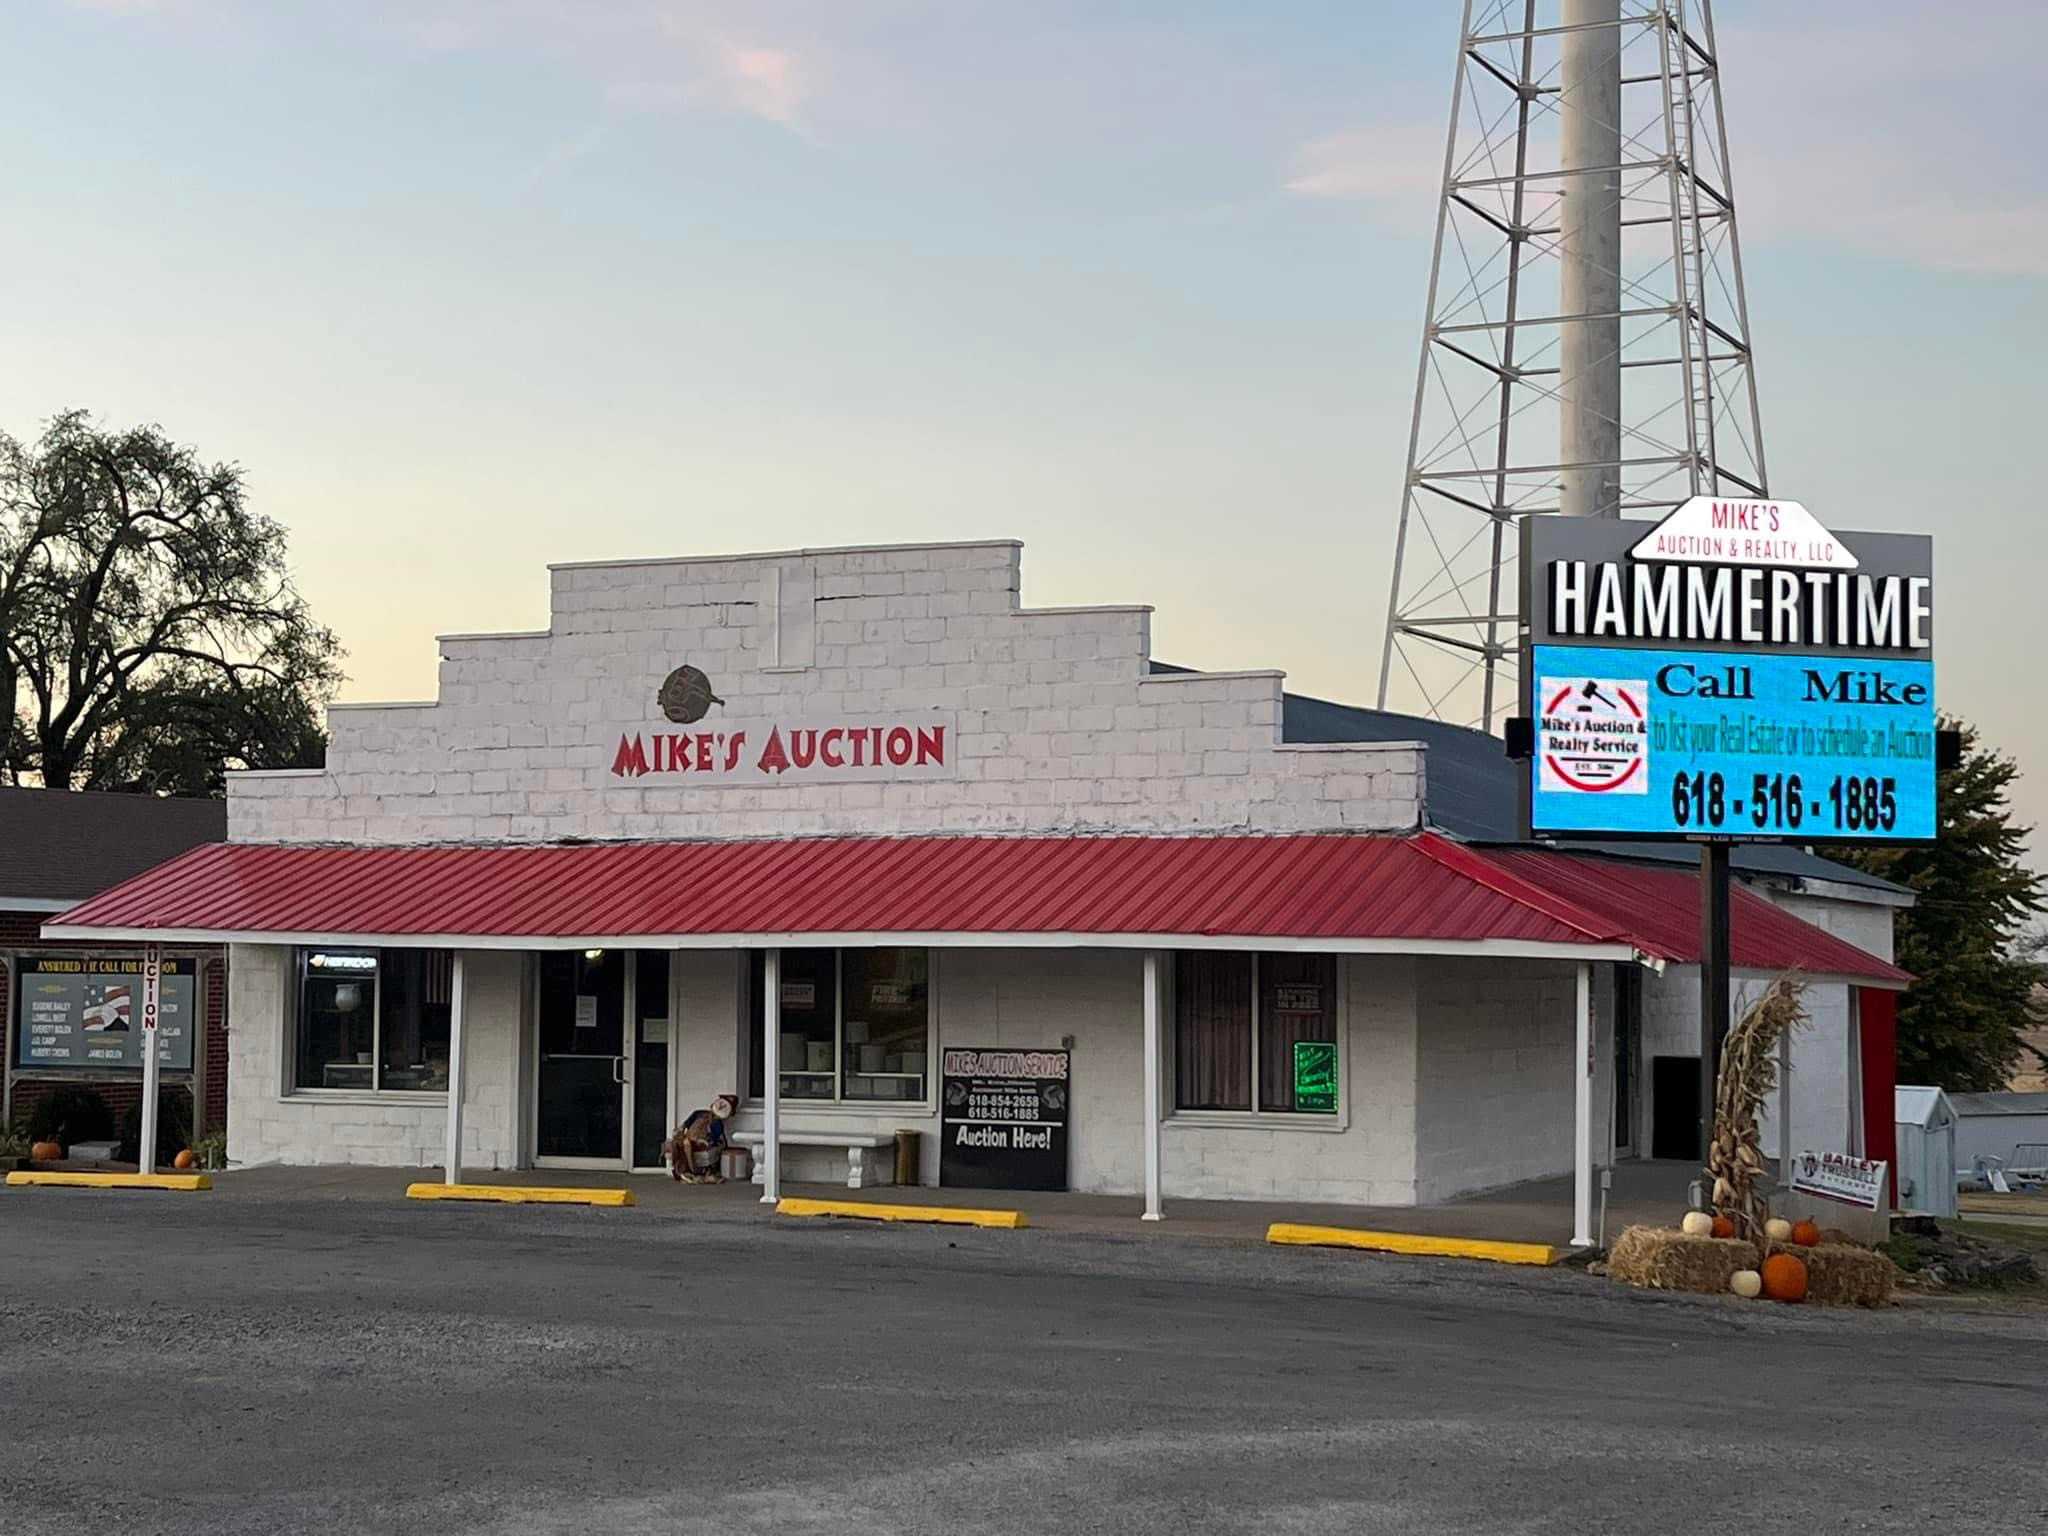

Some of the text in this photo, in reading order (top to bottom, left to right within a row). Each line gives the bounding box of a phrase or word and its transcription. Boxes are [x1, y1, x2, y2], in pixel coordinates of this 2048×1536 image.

[1711, 502, 1780, 531] MIKE'S
[1656, 534, 1722, 557] AUCTION
[1729, 538, 1738, 558] &
[1809, 542, 1834, 562] LLC
[1550, 560, 1931, 649] HAMMERTIME
[1655, 663, 1928, 706] Call Mike
[1541, 717, 1647, 734] Mike's Auction &
[1720, 711, 1745, 753] Real
[610, 724, 946, 778] MIKE'S AUCTION
[1549, 736, 1639, 753] Realty Service
[99, 961, 119, 973] CALL
[977, 1052, 1024, 1078] AUCTION
[956, 1125, 1052, 1150] Auction Here!
[1823, 1153, 1880, 1173] BAILEY
